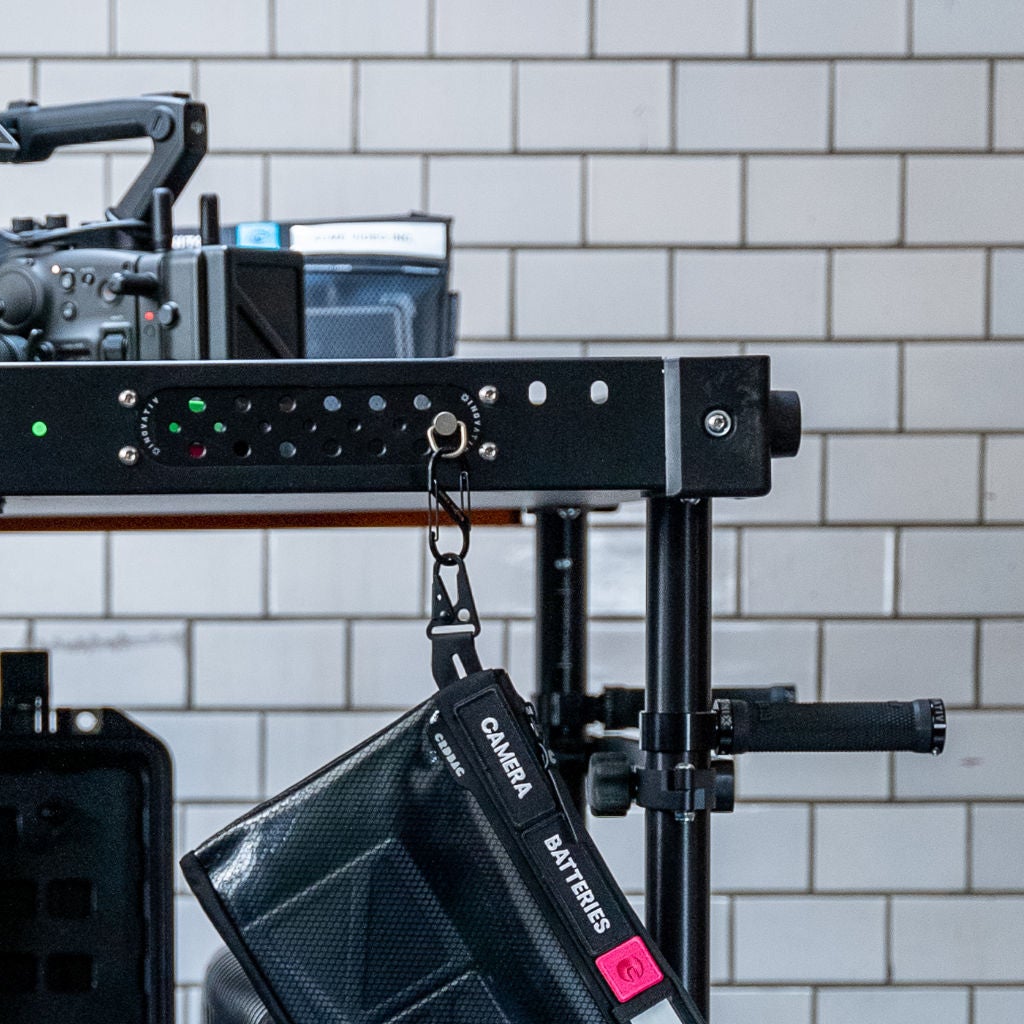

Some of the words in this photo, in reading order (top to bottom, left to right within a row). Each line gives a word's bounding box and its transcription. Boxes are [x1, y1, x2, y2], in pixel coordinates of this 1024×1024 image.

[140, 396, 159, 449] INOVATIV
[480, 716, 533, 800] CAMERA
[543, 833, 611, 934] BATTERIES
